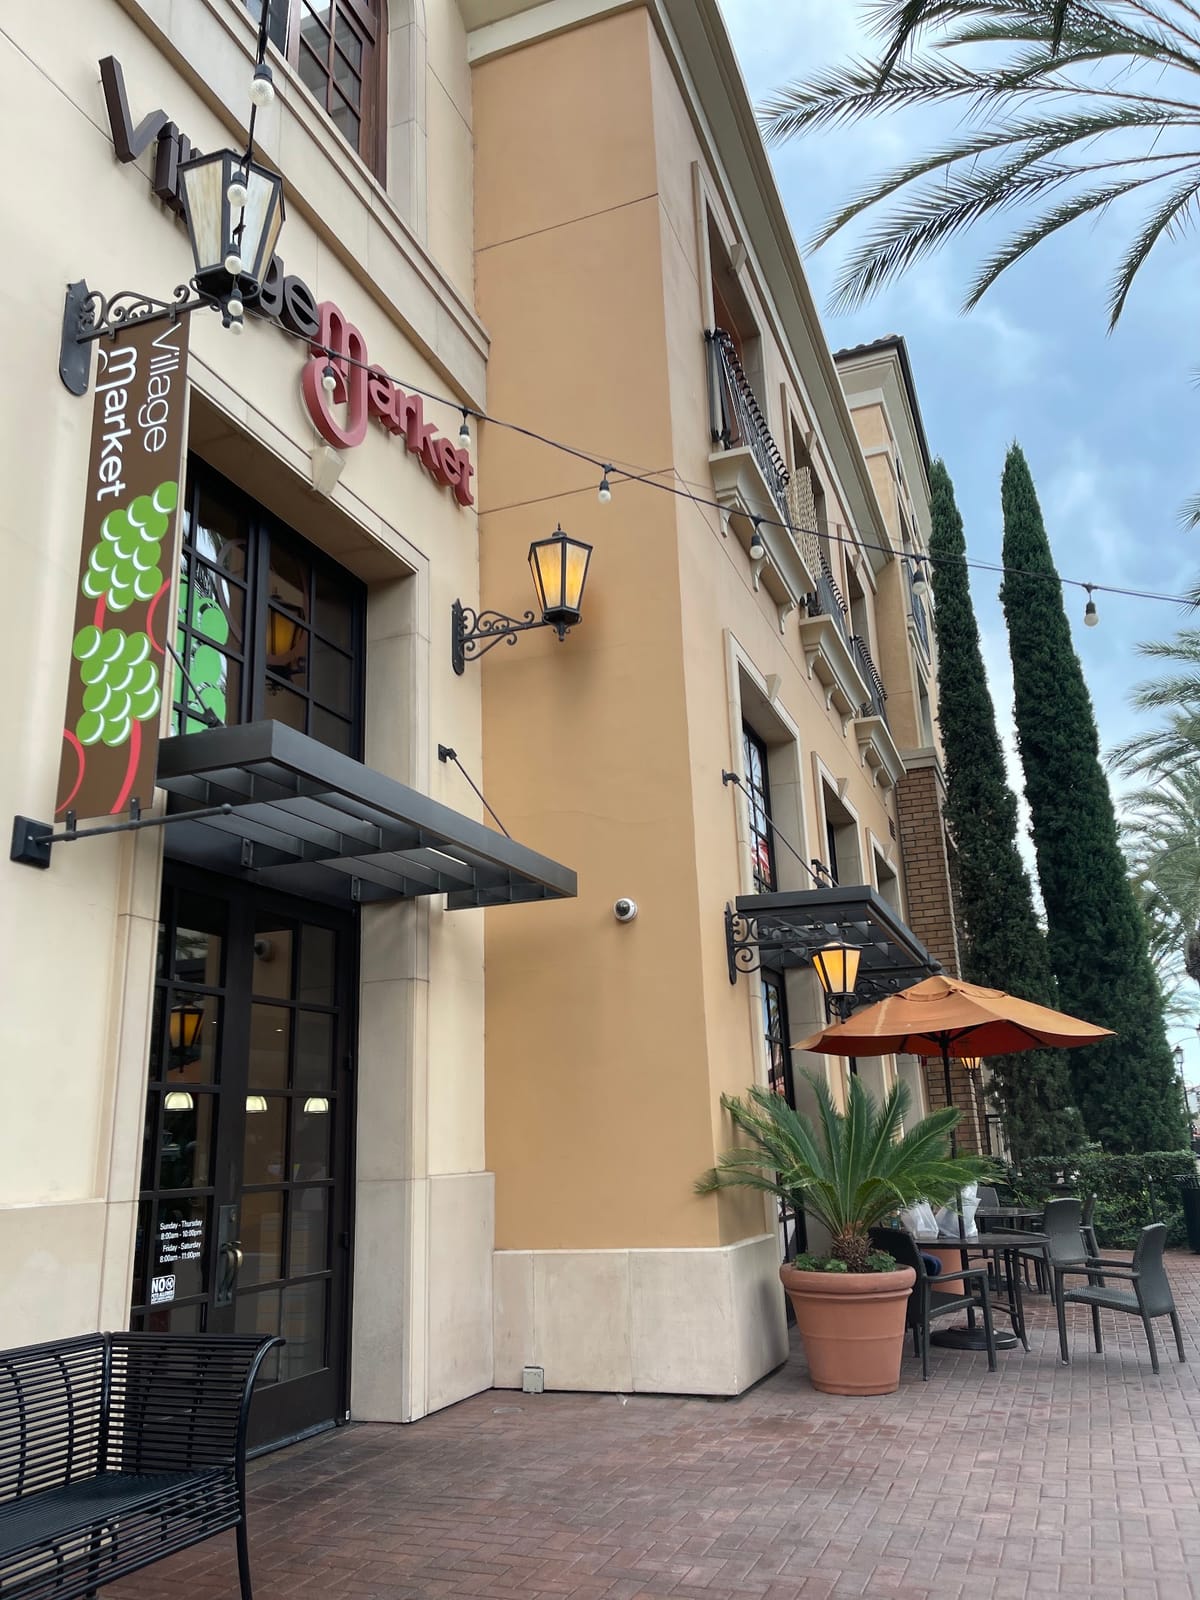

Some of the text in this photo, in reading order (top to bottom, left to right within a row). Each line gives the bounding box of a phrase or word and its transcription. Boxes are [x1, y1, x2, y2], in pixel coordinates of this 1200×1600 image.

[138, 322, 182, 452] Village
[302, 300, 474, 507] Market
[95, 346, 137, 502] Market
[160, 1222, 178, 1231] Sunday
[181, 1219, 202, 1228] Thursday
[162, 1244, 178, 1252] Friday
[181, 1241, 201, 1250] Saturday
[152, 1278, 165, 1293] NO
